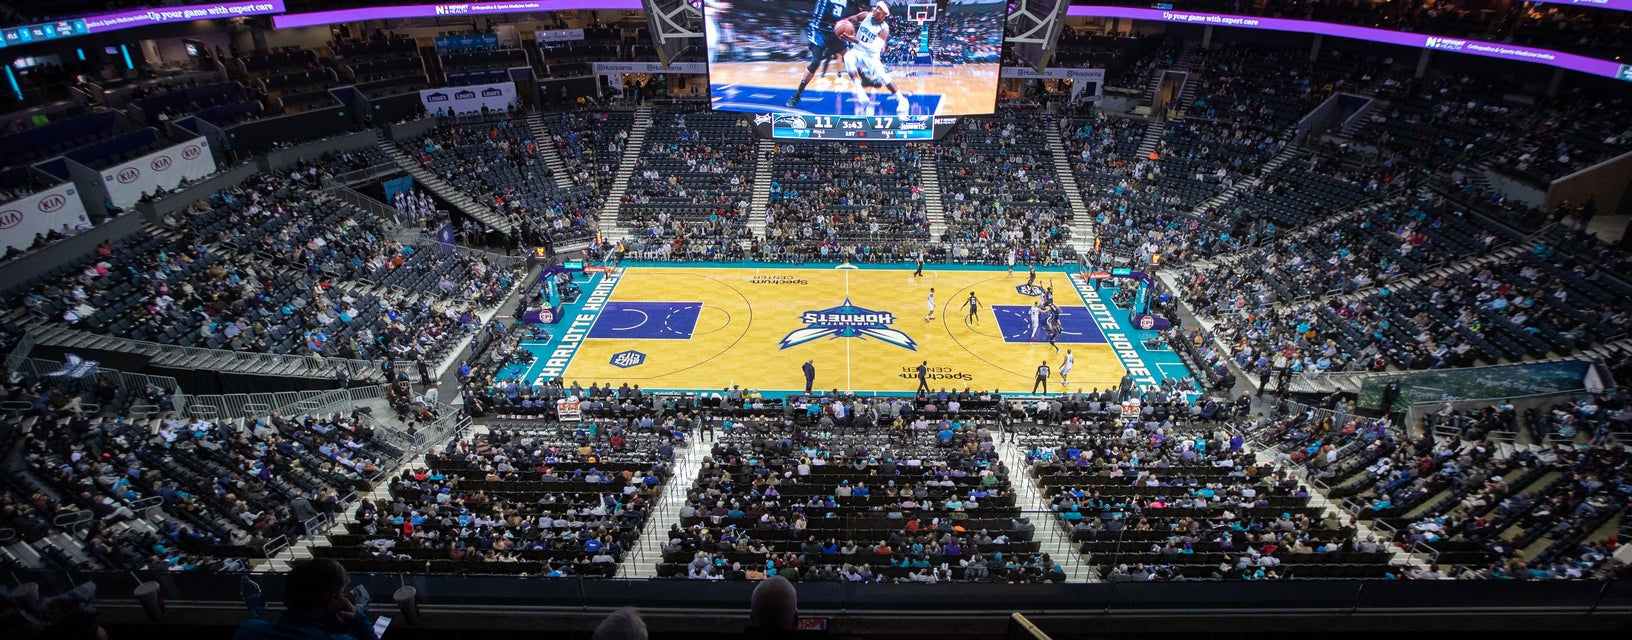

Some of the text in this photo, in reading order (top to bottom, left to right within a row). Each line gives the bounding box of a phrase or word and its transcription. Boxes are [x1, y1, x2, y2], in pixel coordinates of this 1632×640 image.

[148, 11, 162, 21] Up
[162, 11, 183, 21] your
[184, 9, 207, 19] game
[208, 7, 229, 16] with
[228, 5, 255, 15] expert
[814, 117, 833, 128] 11
[875, 118, 892, 128] 17
[184, 147, 198, 157] KIA
[154, 158, 169, 168] KIA
[120, 170, 137, 181] KIA
[42, 197, 62, 210] KIA
[0, 213, 19, 226] KIA
[805, 313, 891, 323] HORNETS
[903, 373, 973, 381] Spectrm
